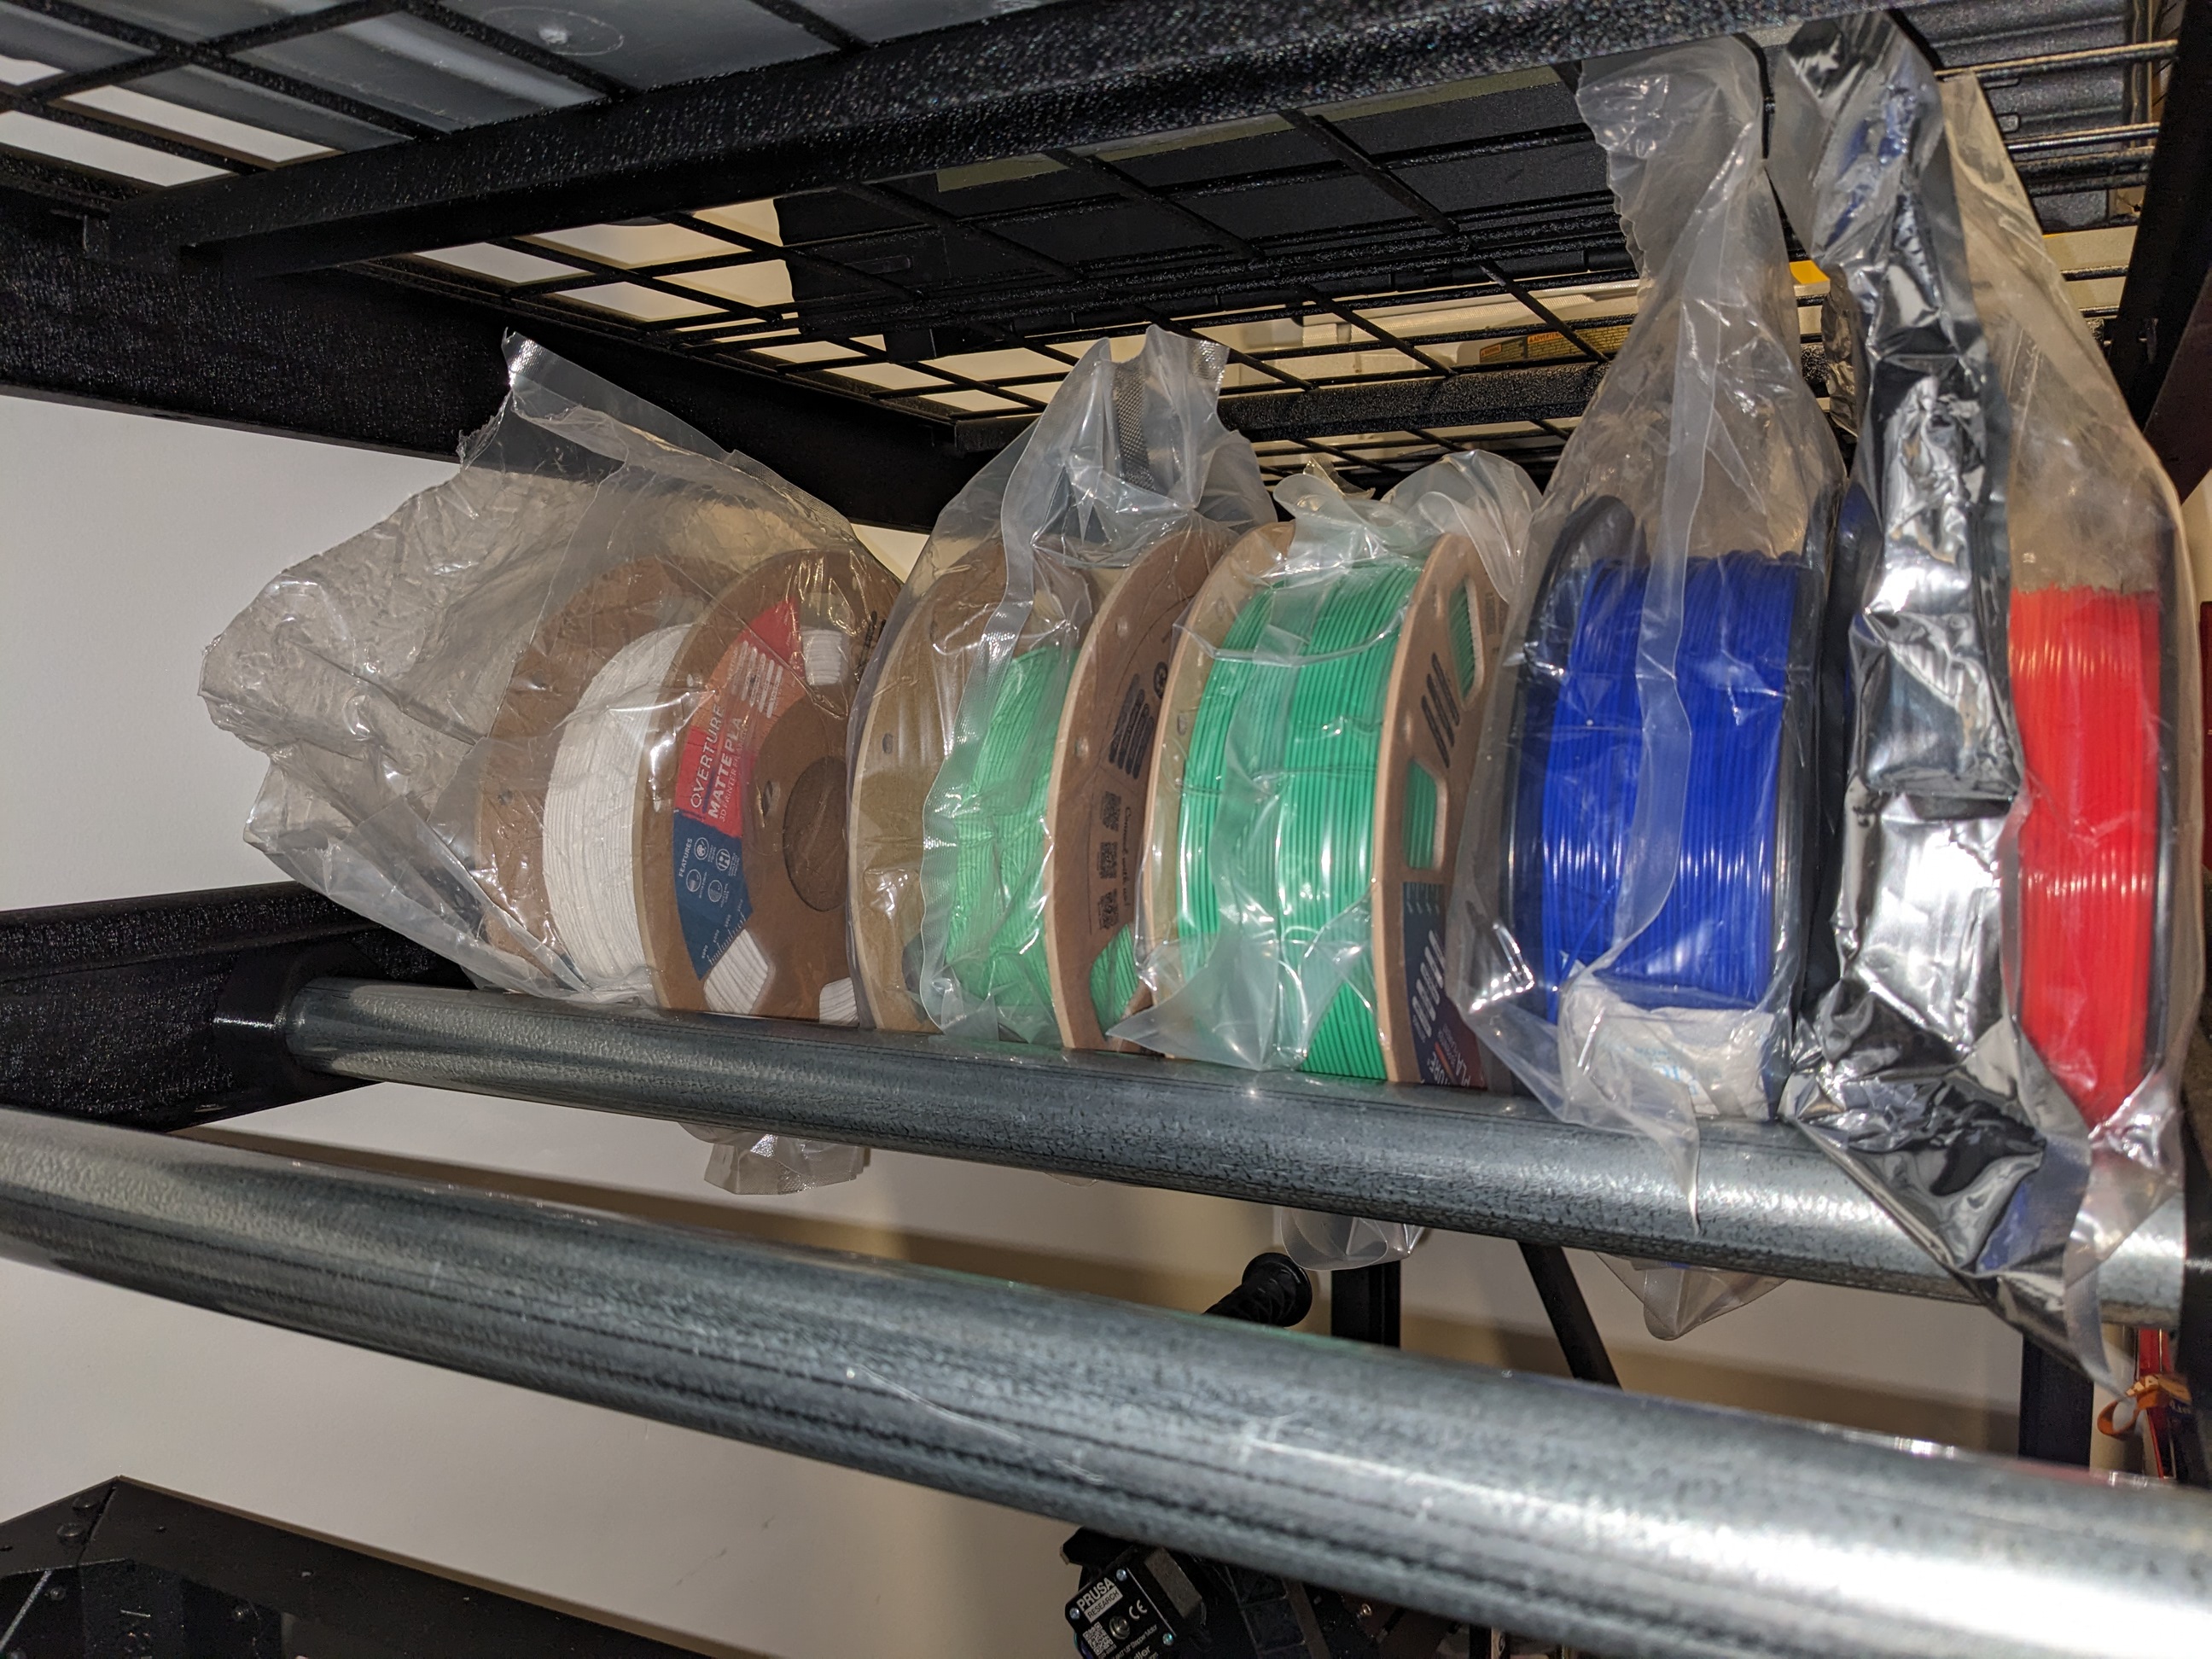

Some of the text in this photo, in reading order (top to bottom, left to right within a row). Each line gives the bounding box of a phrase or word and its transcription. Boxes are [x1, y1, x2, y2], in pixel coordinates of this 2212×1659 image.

[690, 703, 725, 808] OVERTURE
[707, 718, 742, 819] MATTE PLA
[719, 809, 727, 823] 3D
[725, 769, 737, 809] PRINTER
[678, 838, 692, 877] FEATURES
[1076, 1577, 1115, 1611] PRUSA
[1087, 1589, 1121, 1618] RESEARCH
